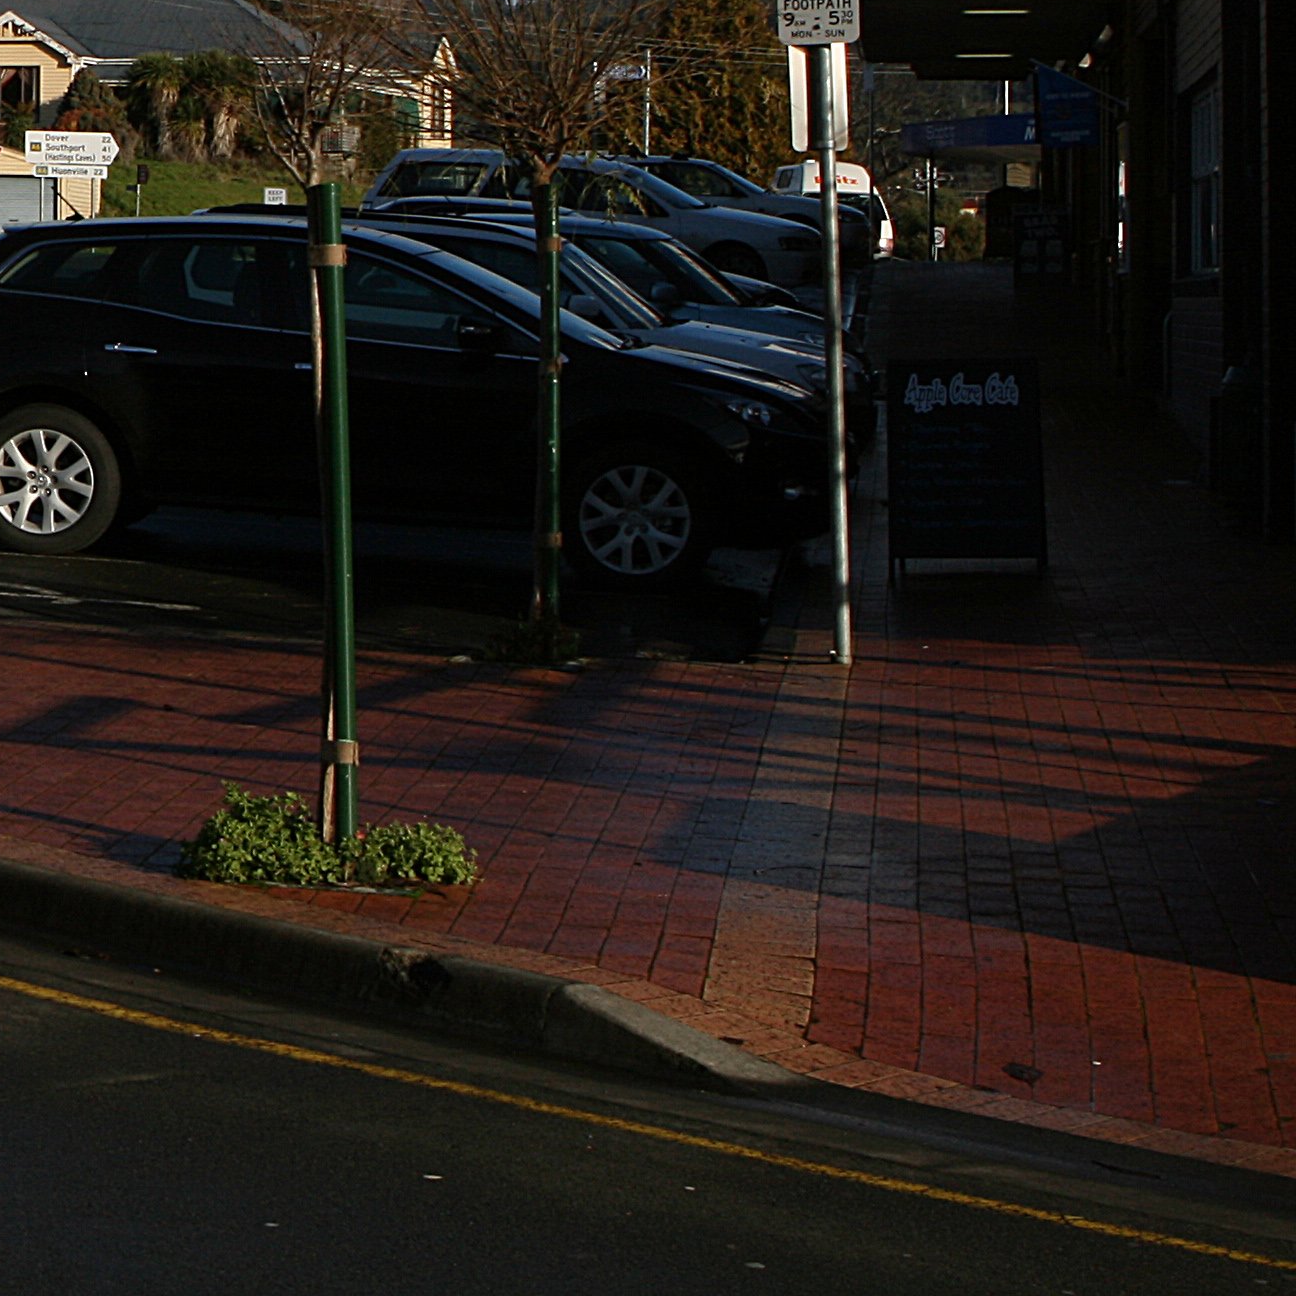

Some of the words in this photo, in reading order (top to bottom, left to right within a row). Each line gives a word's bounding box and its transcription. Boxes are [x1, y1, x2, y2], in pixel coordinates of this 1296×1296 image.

[791, 30, 812, 38] MON
[825, 29, 845, 37] SUN
[45, 134, 69, 142] Dover
[46, 143, 85, 153] Southport
[45, 154, 74, 163] (Hastings
[76, 154, 96, 162] Caves)
[904, 373, 947, 413] Apple
[949, 372, 983, 406] Core
[985, 372, 1020, 406] Cafe
